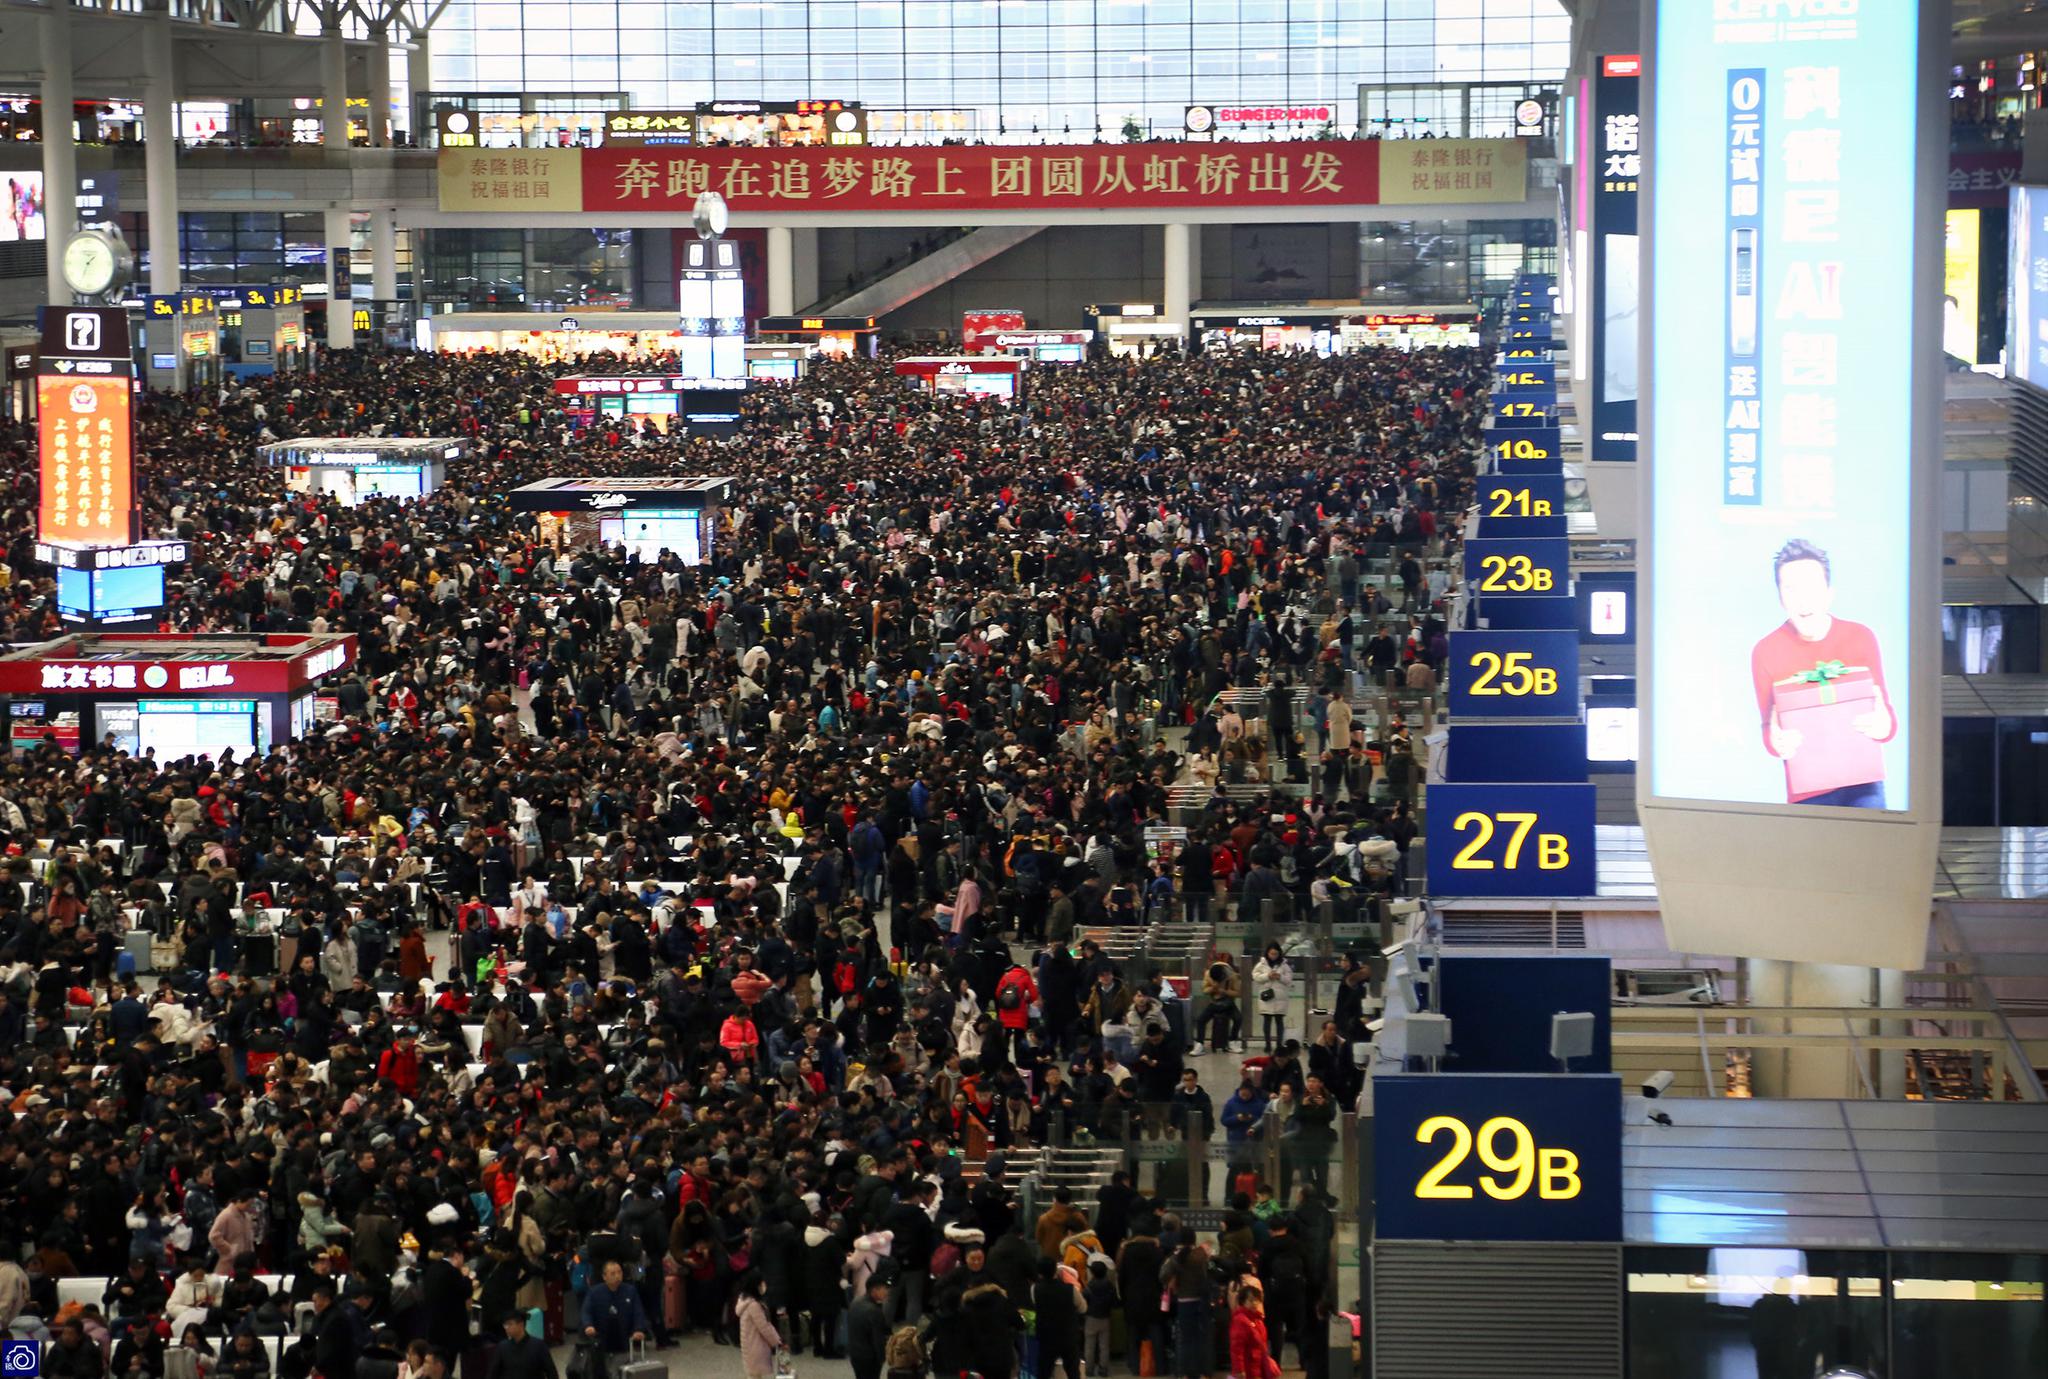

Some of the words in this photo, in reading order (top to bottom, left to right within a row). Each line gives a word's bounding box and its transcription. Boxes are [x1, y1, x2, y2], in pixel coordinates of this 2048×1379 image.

[1412, 148, 1493, 167] 泰隆银行
[1731, 77, 1760, 217] 0元试用
[471, 158, 550, 176] 泰隆银行
[615, 158, 966, 201] 奔跑在追梦路上
[991, 152, 1344, 197] 团圆从虹桥出发
[1948, 167, 2023, 191] 会主义
[470, 181, 550, 199] 祝福祖国
[1412, 172, 1493, 190] 祝福祖国
[153, 300, 173, 315] 5A
[248, 291, 266, 304] 3A
[1490, 489, 1552, 517] 21B
[1481, 555, 1554, 592] 23B
[1469, 651, 1558, 696] 25B
[1452, 811, 1570, 870] 27B
[1415, 1115, 1582, 1201] 29B
